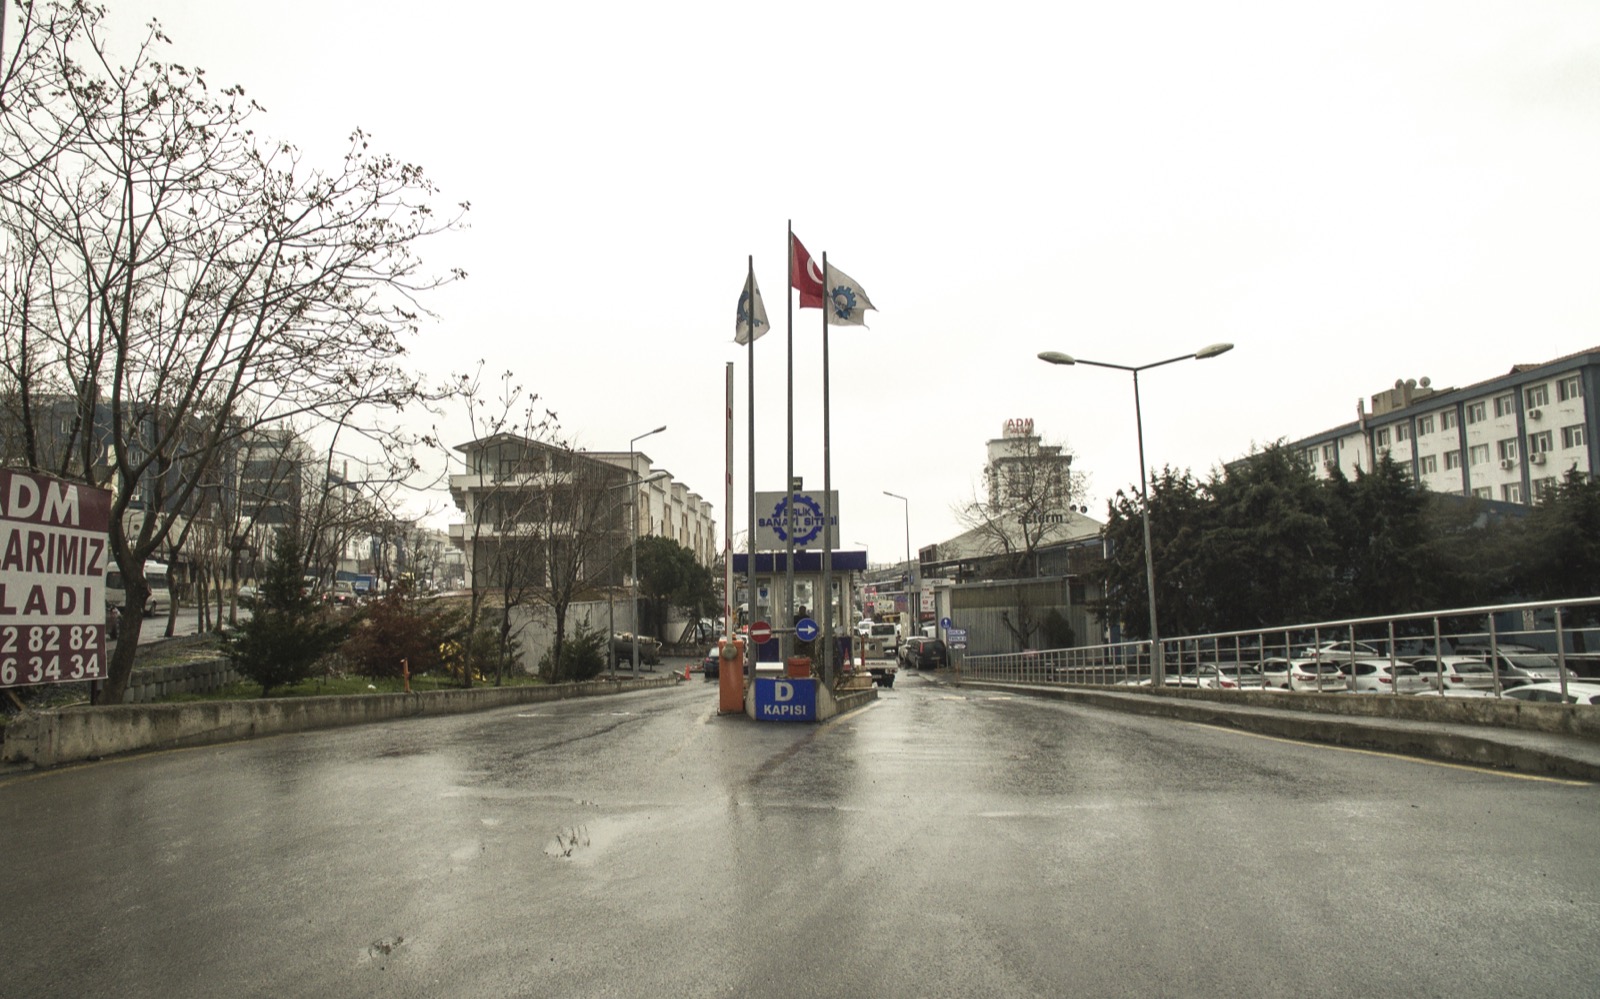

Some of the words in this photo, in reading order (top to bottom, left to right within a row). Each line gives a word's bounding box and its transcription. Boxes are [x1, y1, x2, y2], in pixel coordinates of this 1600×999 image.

[1007, 417, 1034, 428] ADM
[0, 473, 80, 526] DM
[783, 507, 811, 517] BRLİK
[28, 626, 60, 652] 82
[69, 626, 98, 650] 82
[28, 655, 61, 683] 34
[70, 654, 100, 679] 34
[774, 681, 794, 702] D
[763, 704, 806, 716] KAPISI
